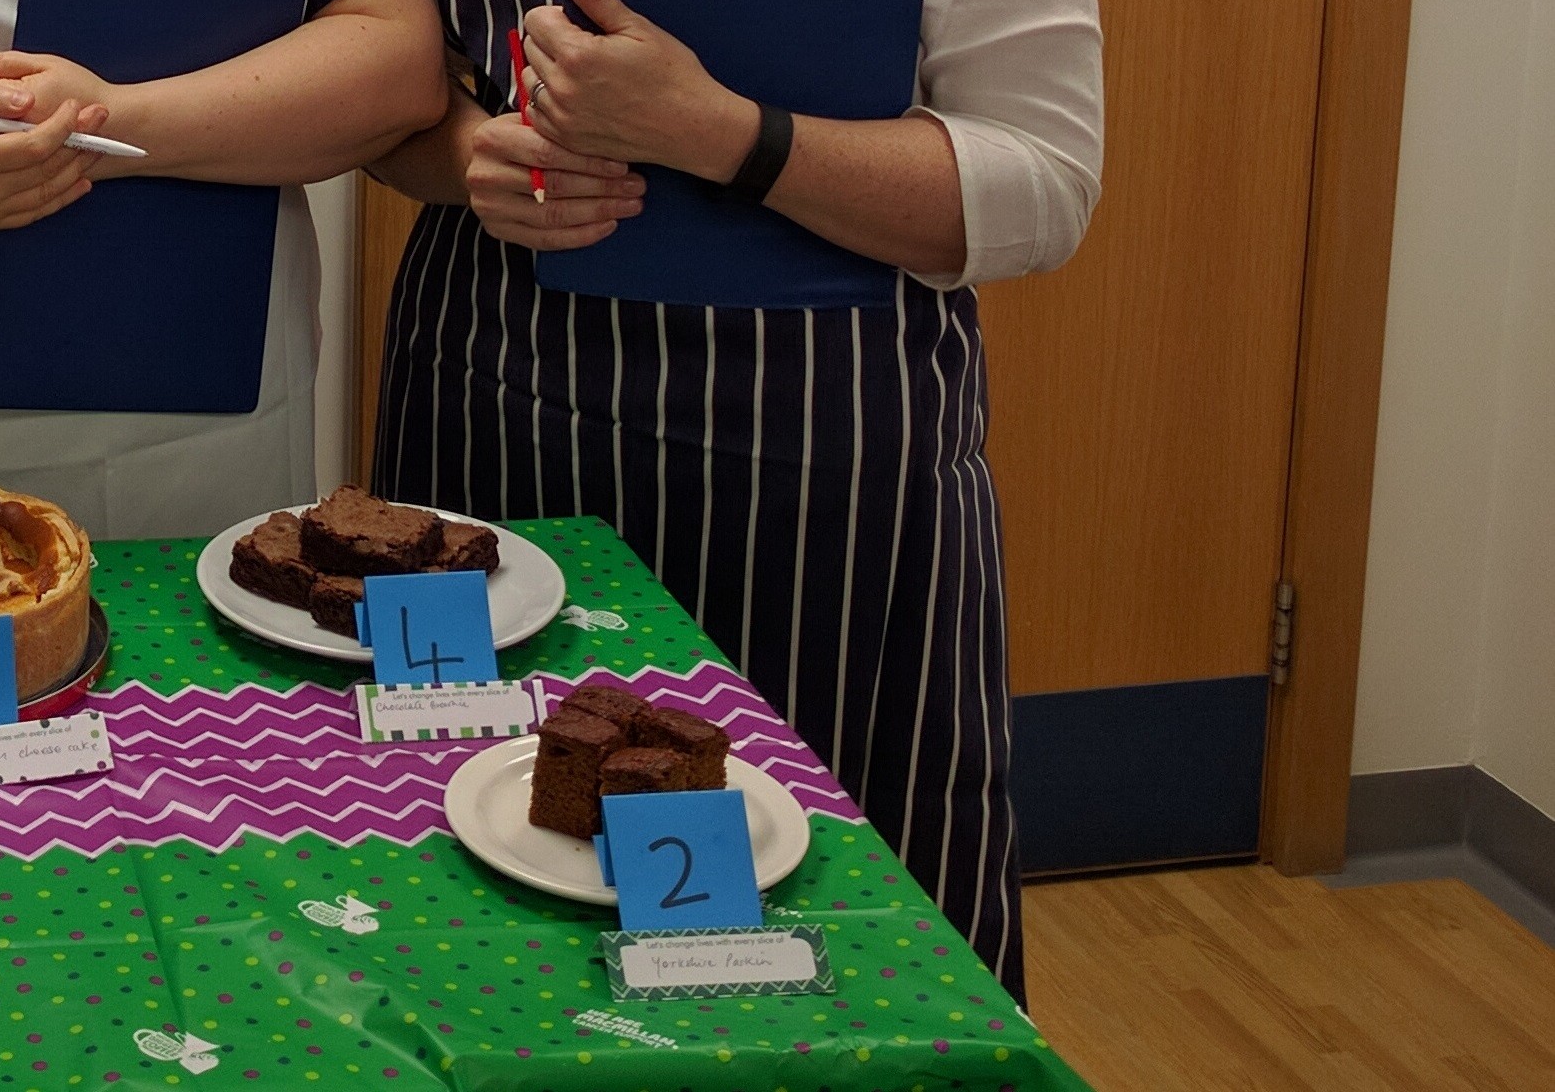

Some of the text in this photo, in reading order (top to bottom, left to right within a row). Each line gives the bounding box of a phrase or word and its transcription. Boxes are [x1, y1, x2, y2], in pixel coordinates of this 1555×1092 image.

[400, 605, 464, 684] 4
[408, 692, 434, 701] change
[451, 690, 466, 698] with
[467, 690, 485, 699] every
[486, 688, 500, 696] slice
[14, 731, 28, 740] with
[29, 730, 47, 740] every
[48, 726, 64, 736] slice
[65, 725, 72, 733] of
[649, 836, 710, 909] 2
[646, 935, 784, 950] Let's change lives with every slice of
[587, 1009, 645, 1028] WE ARE
